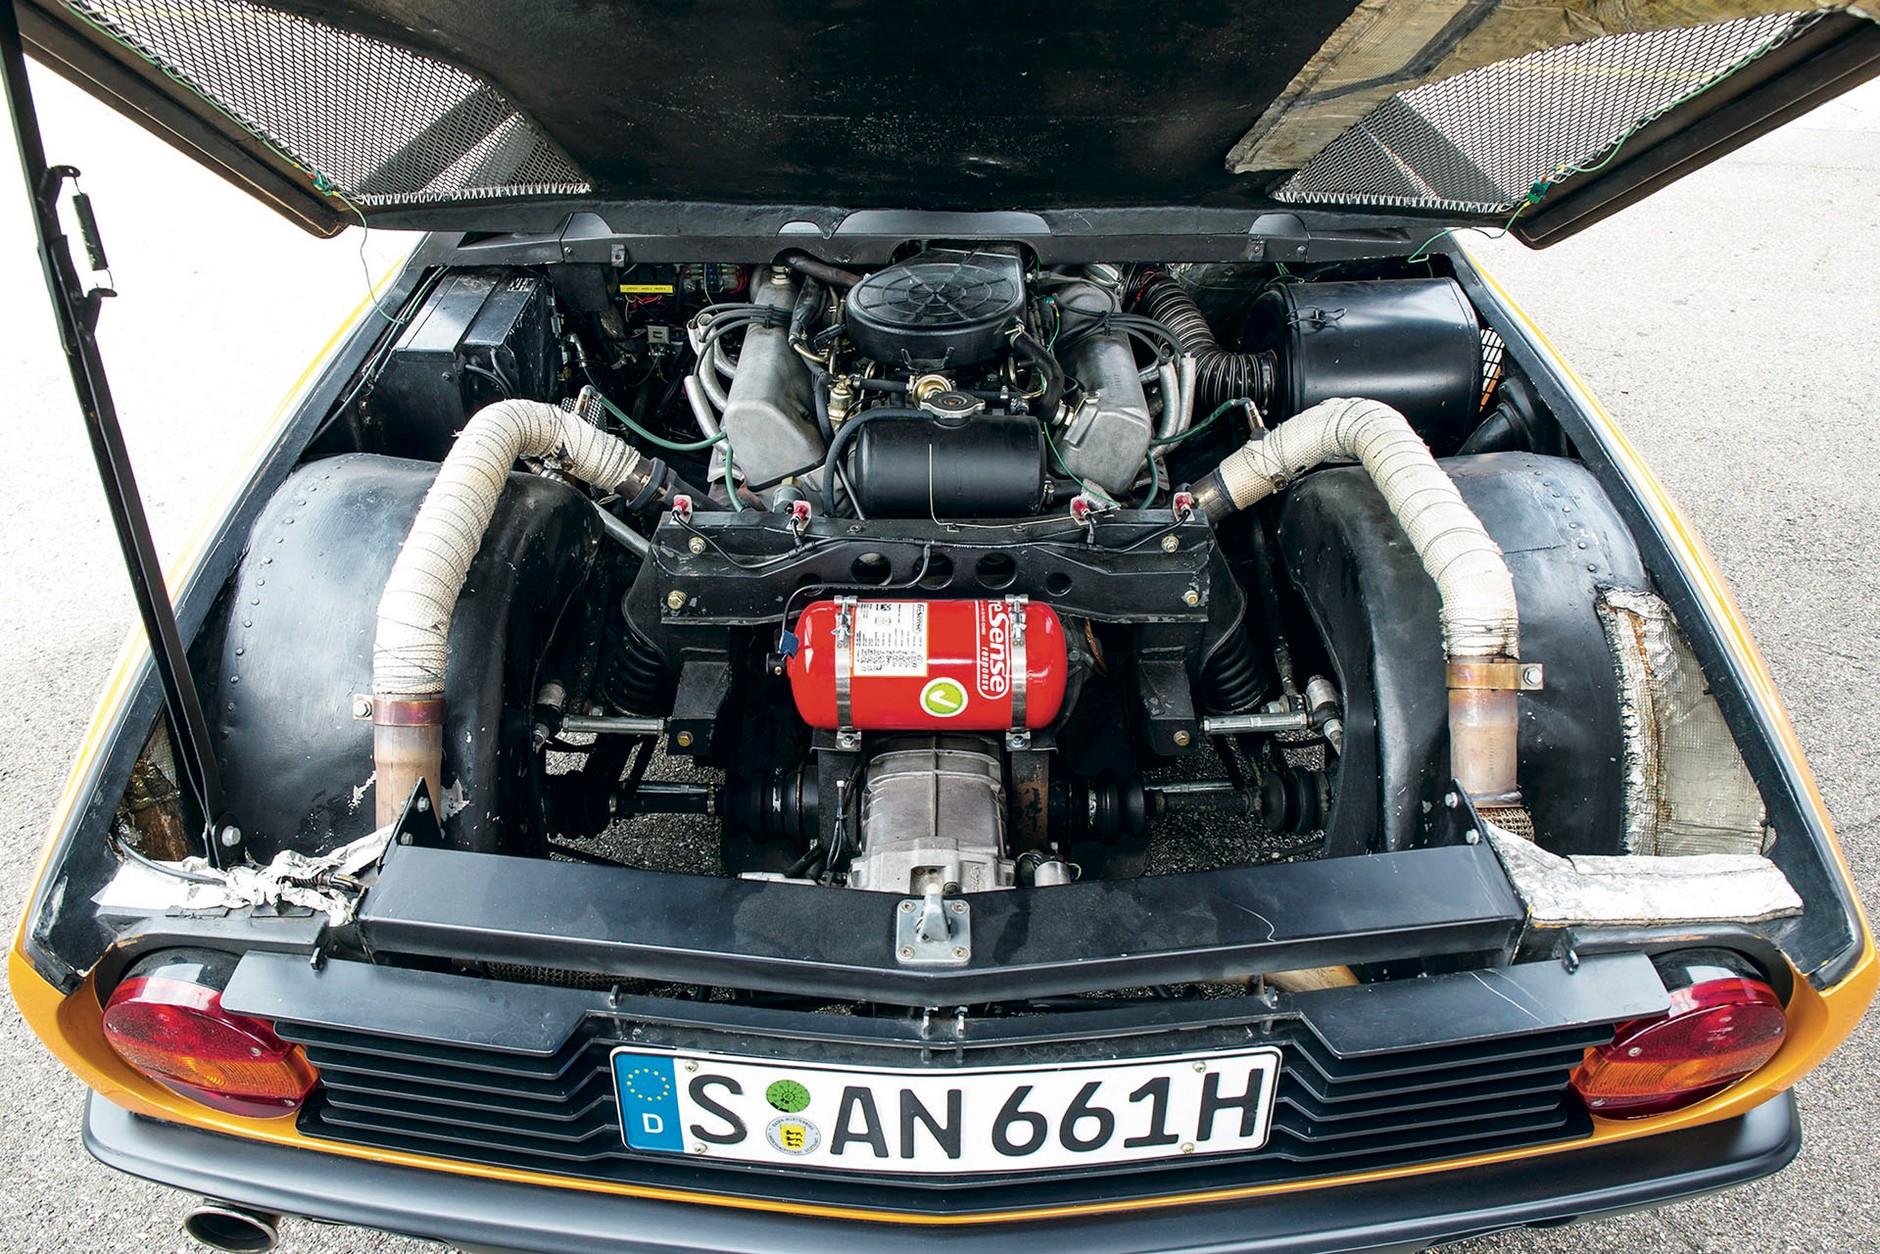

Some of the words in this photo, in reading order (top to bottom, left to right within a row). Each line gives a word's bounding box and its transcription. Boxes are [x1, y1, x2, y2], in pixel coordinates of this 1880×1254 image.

[981, 646, 989, 690] response
[988, 600, 1008, 692] reSense
[643, 1113, 663, 1133] D
[688, 1074, 748, 1144] S
[830, 1086, 962, 1160] AN
[991, 1068, 1264, 1158] 661H
